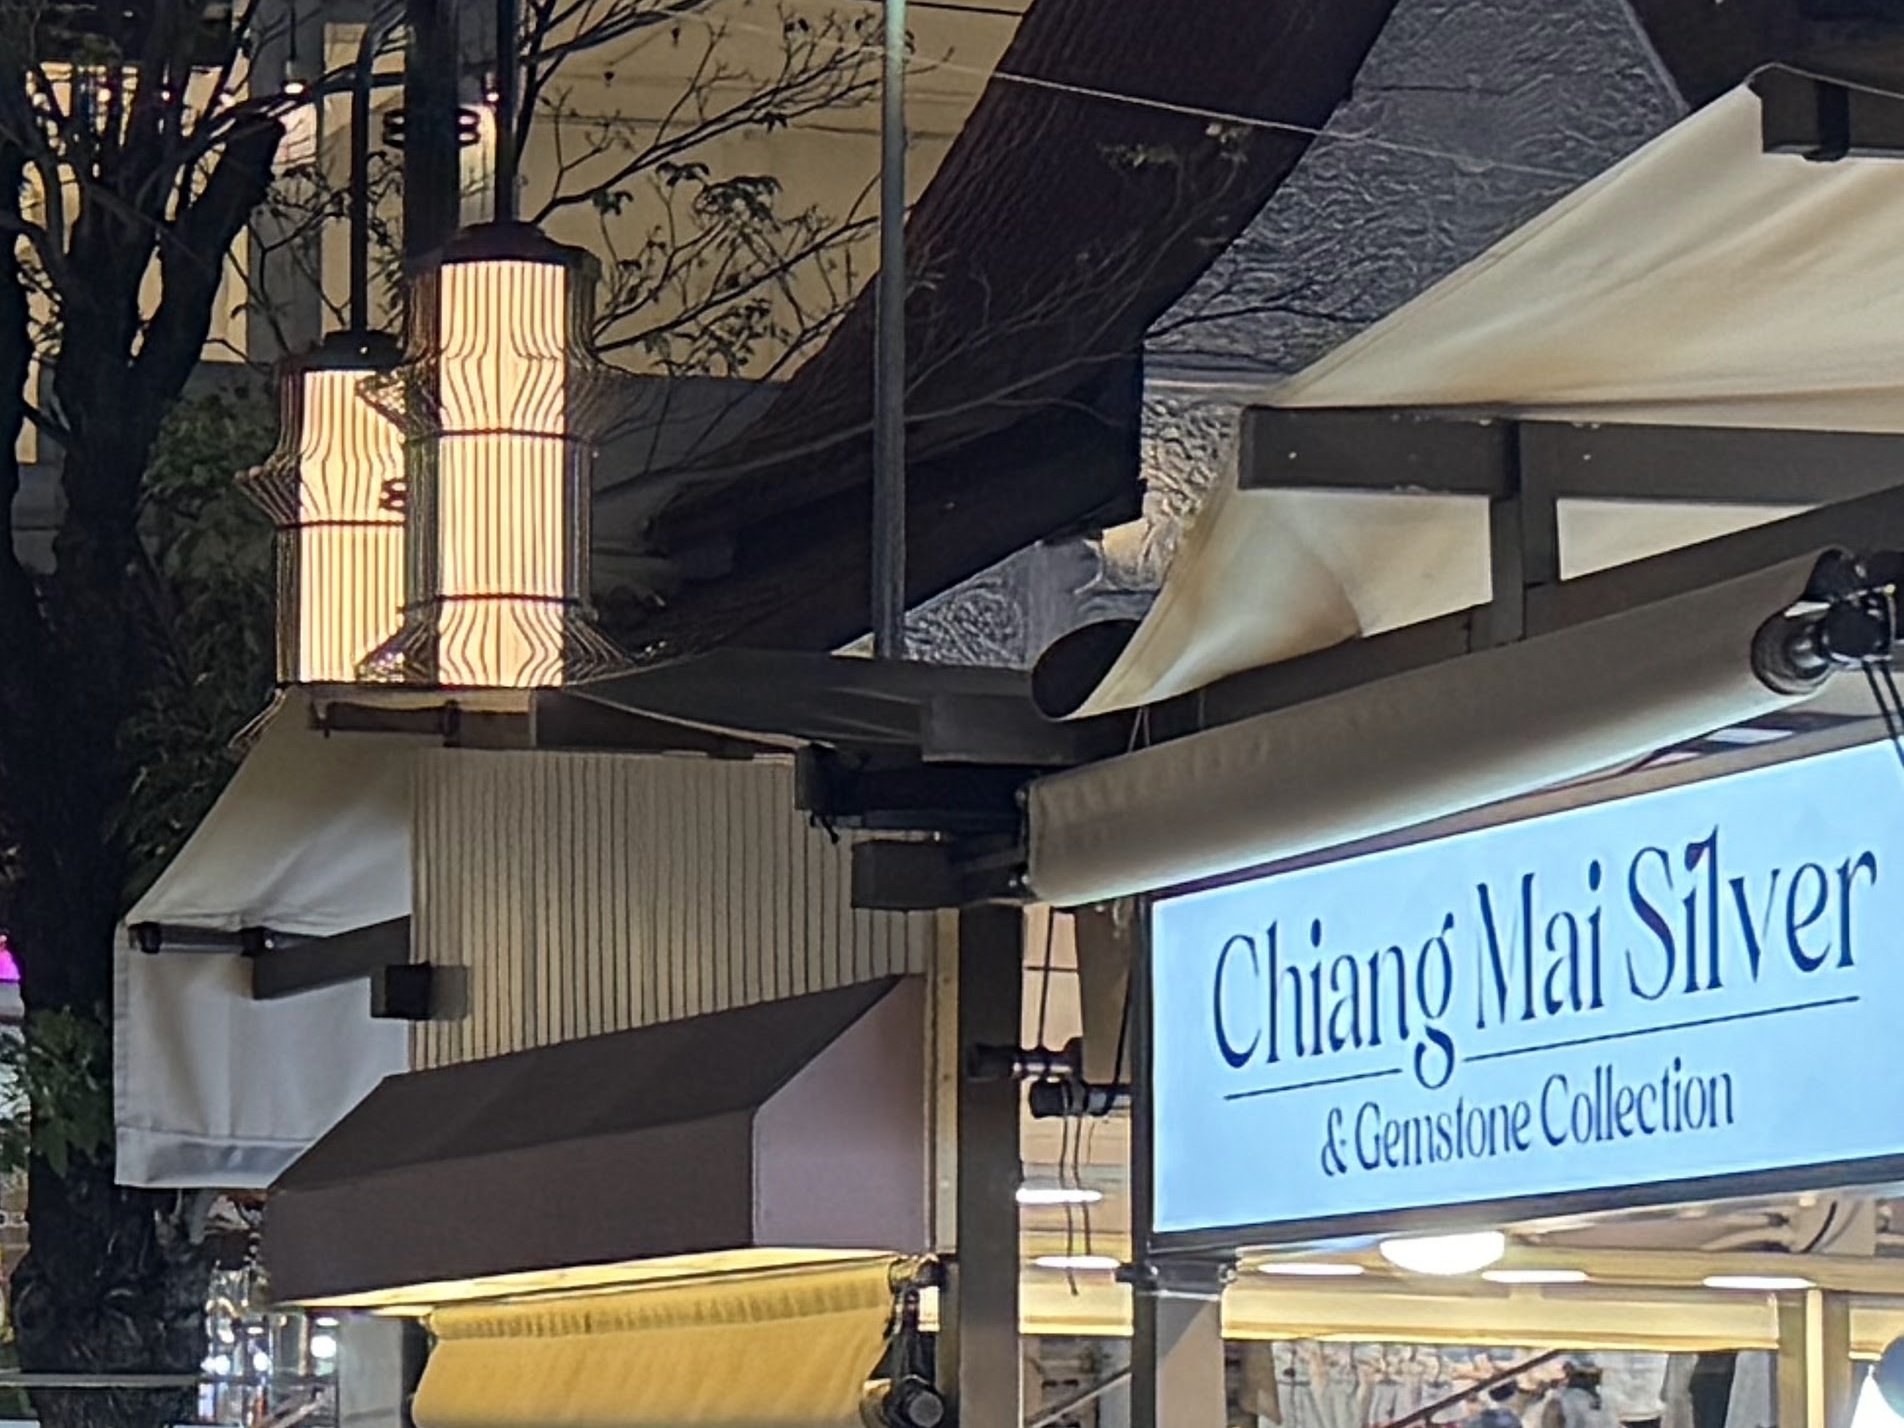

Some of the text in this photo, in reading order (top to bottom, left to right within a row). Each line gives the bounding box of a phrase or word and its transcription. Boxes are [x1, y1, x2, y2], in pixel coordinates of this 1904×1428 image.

[1212, 823, 1878, 1089] Chiang Mai Silver
[1320, 1057, 1736, 1177] & Gemstone Collection
